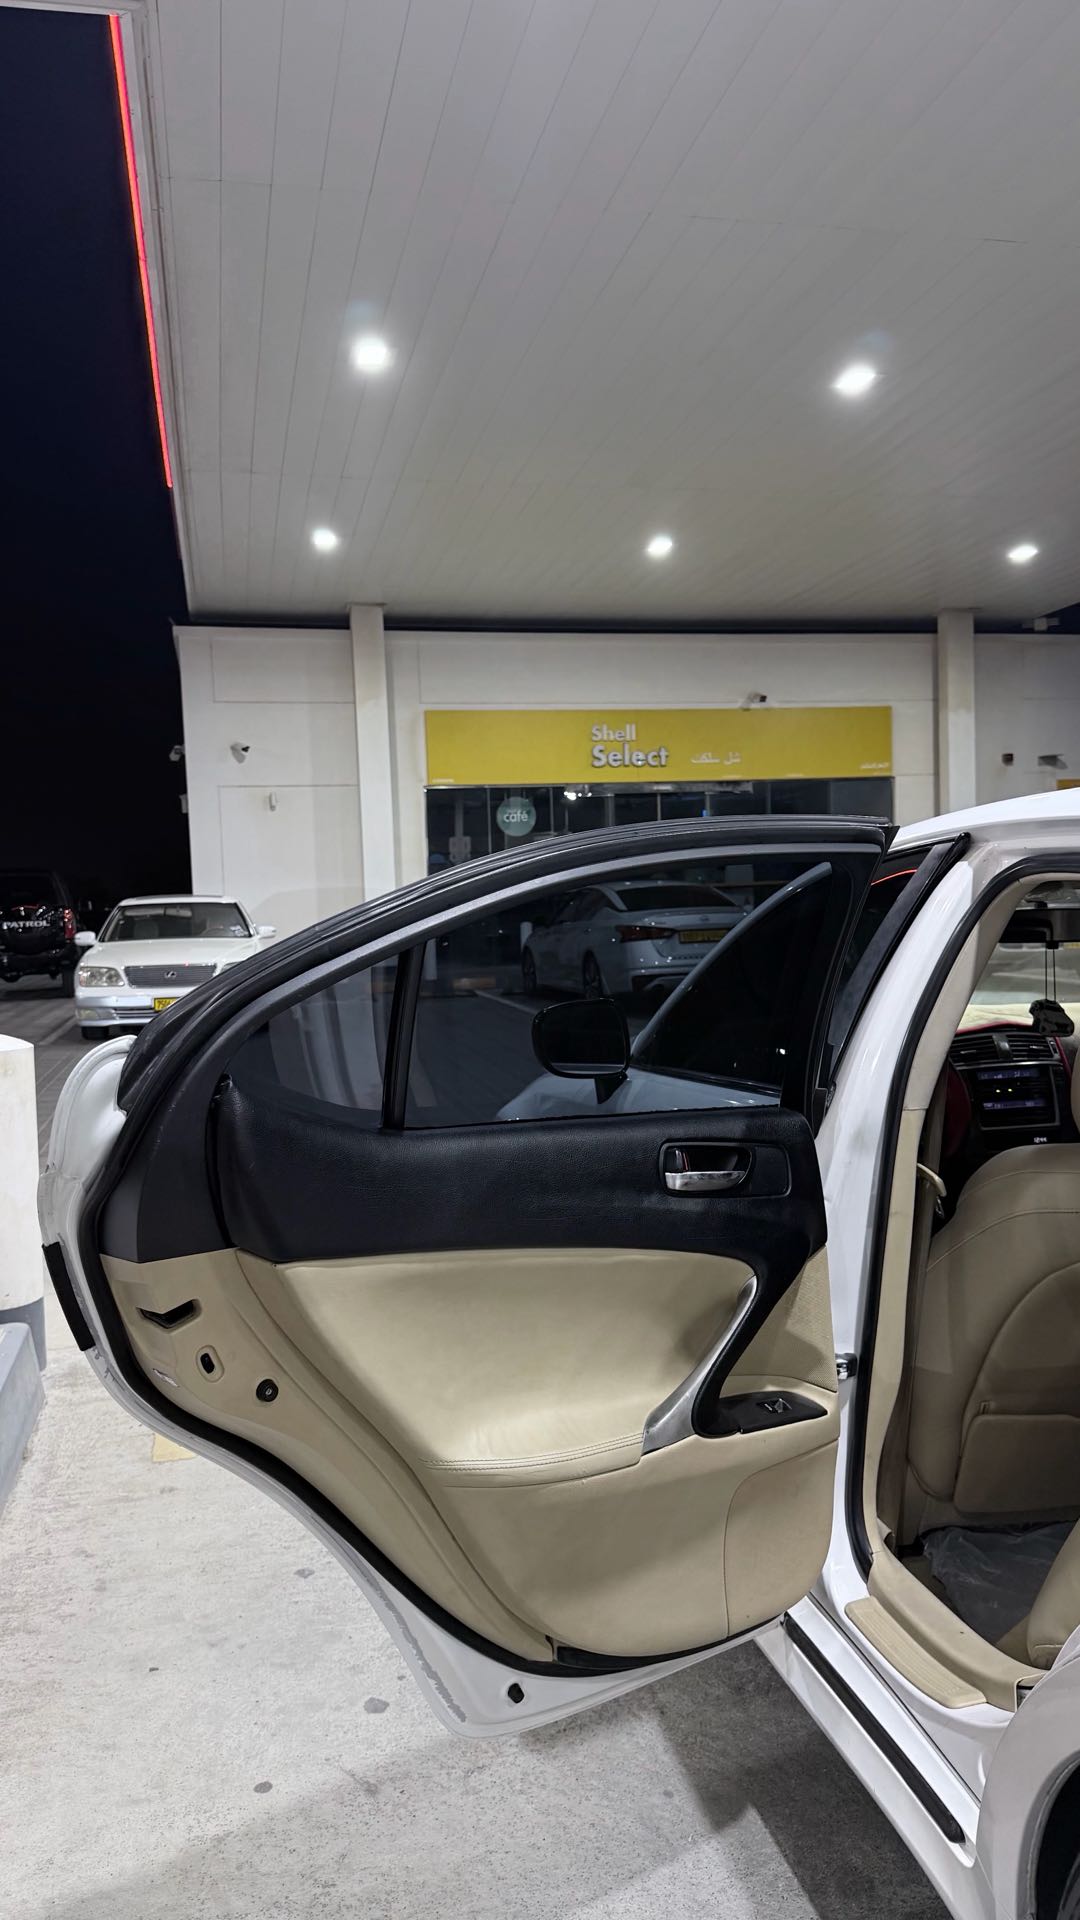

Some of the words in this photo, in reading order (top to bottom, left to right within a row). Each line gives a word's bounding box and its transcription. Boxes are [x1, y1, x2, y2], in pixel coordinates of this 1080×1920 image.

[591, 723, 636, 742] Shell
[591, 743, 669, 768] Select
[503, 808, 529, 823] café
[2, 920, 51, 930] PATROL
